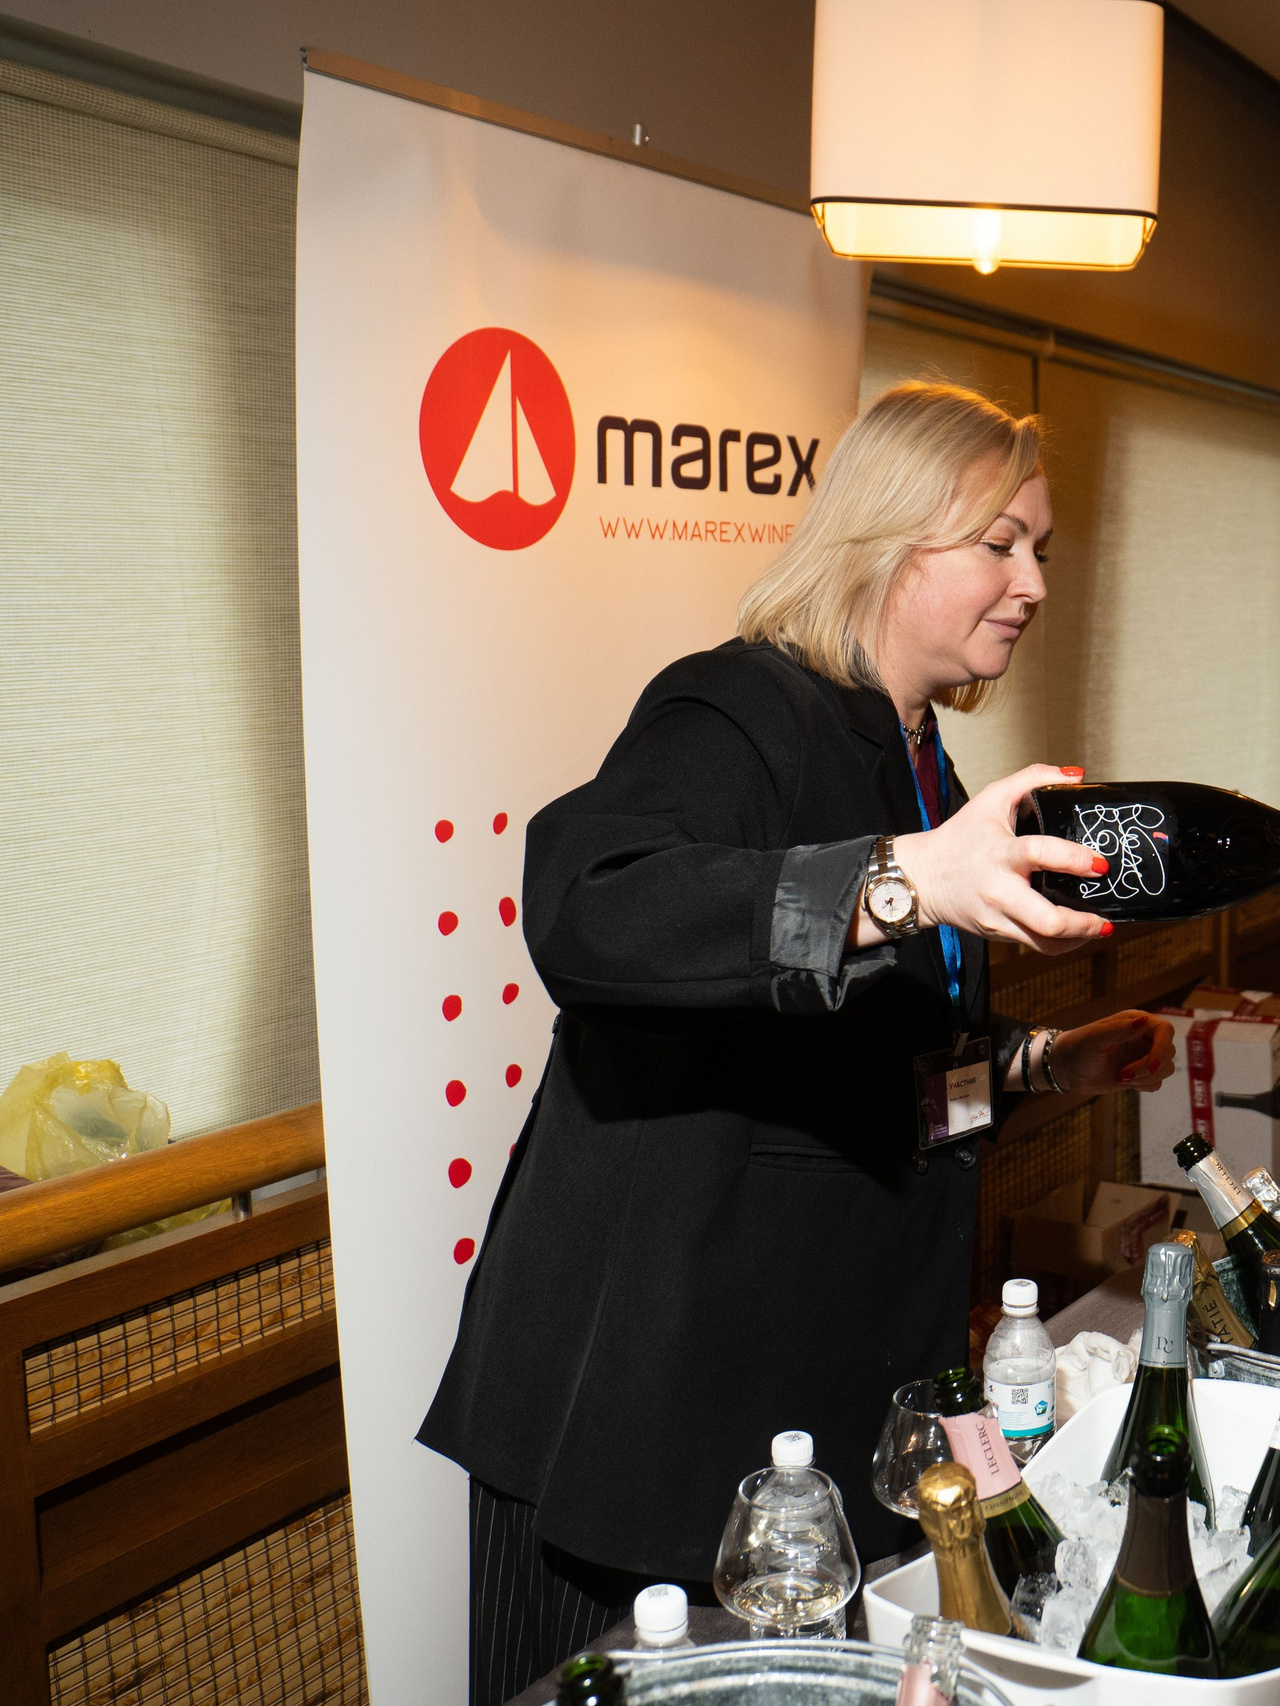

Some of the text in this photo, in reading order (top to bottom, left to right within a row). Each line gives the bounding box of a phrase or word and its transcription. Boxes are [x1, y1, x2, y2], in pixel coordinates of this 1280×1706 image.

[596, 414, 821, 497] marex
[949, 1077, 977, 1090] УЧАСТНИК
[976, 1420, 1000, 1476] LECLERC
